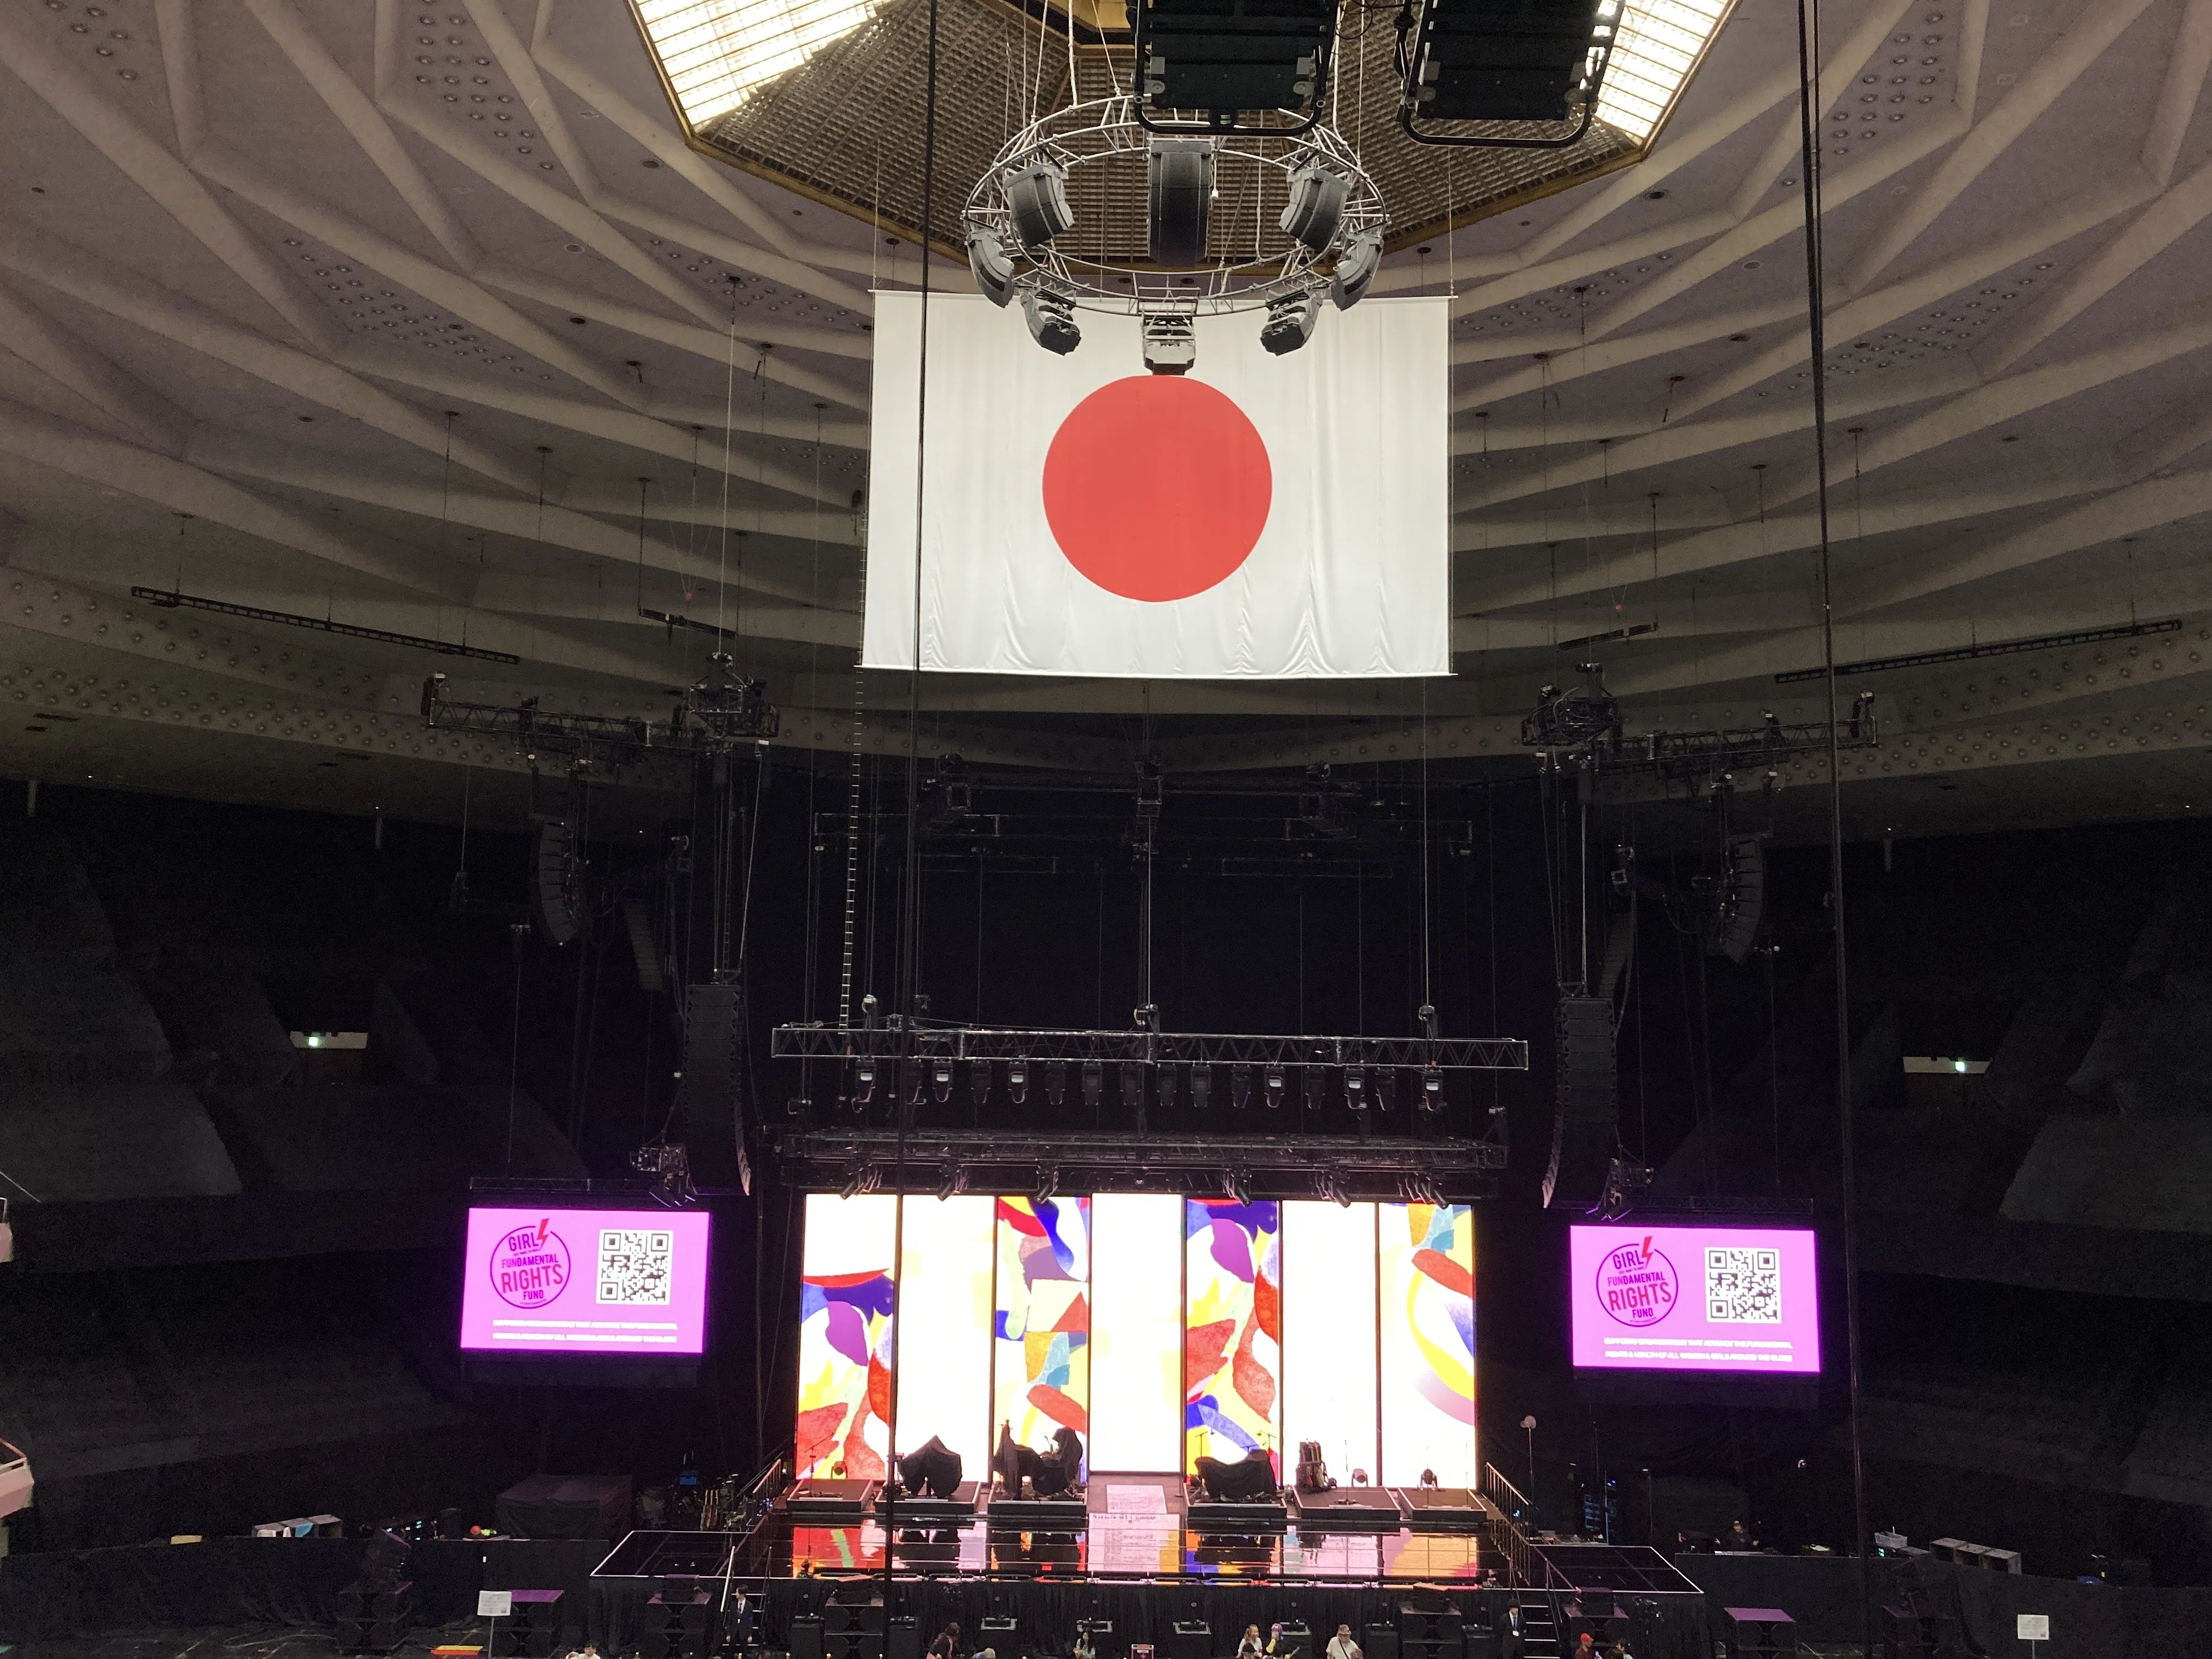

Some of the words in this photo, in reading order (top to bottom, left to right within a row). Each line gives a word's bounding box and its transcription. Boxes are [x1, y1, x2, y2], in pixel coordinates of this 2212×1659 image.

[501, 1254, 559, 1268] FUNDAMENTAL
[501, 1263, 563, 1294] RIGHTS
[1607, 1271, 1666, 1286] FUNDAMENTAL
[523, 1290, 544, 1300] FUND
[1607, 1282, 1672, 1312] RIGHTS
[1632, 1307, 1654, 1319] FUND
